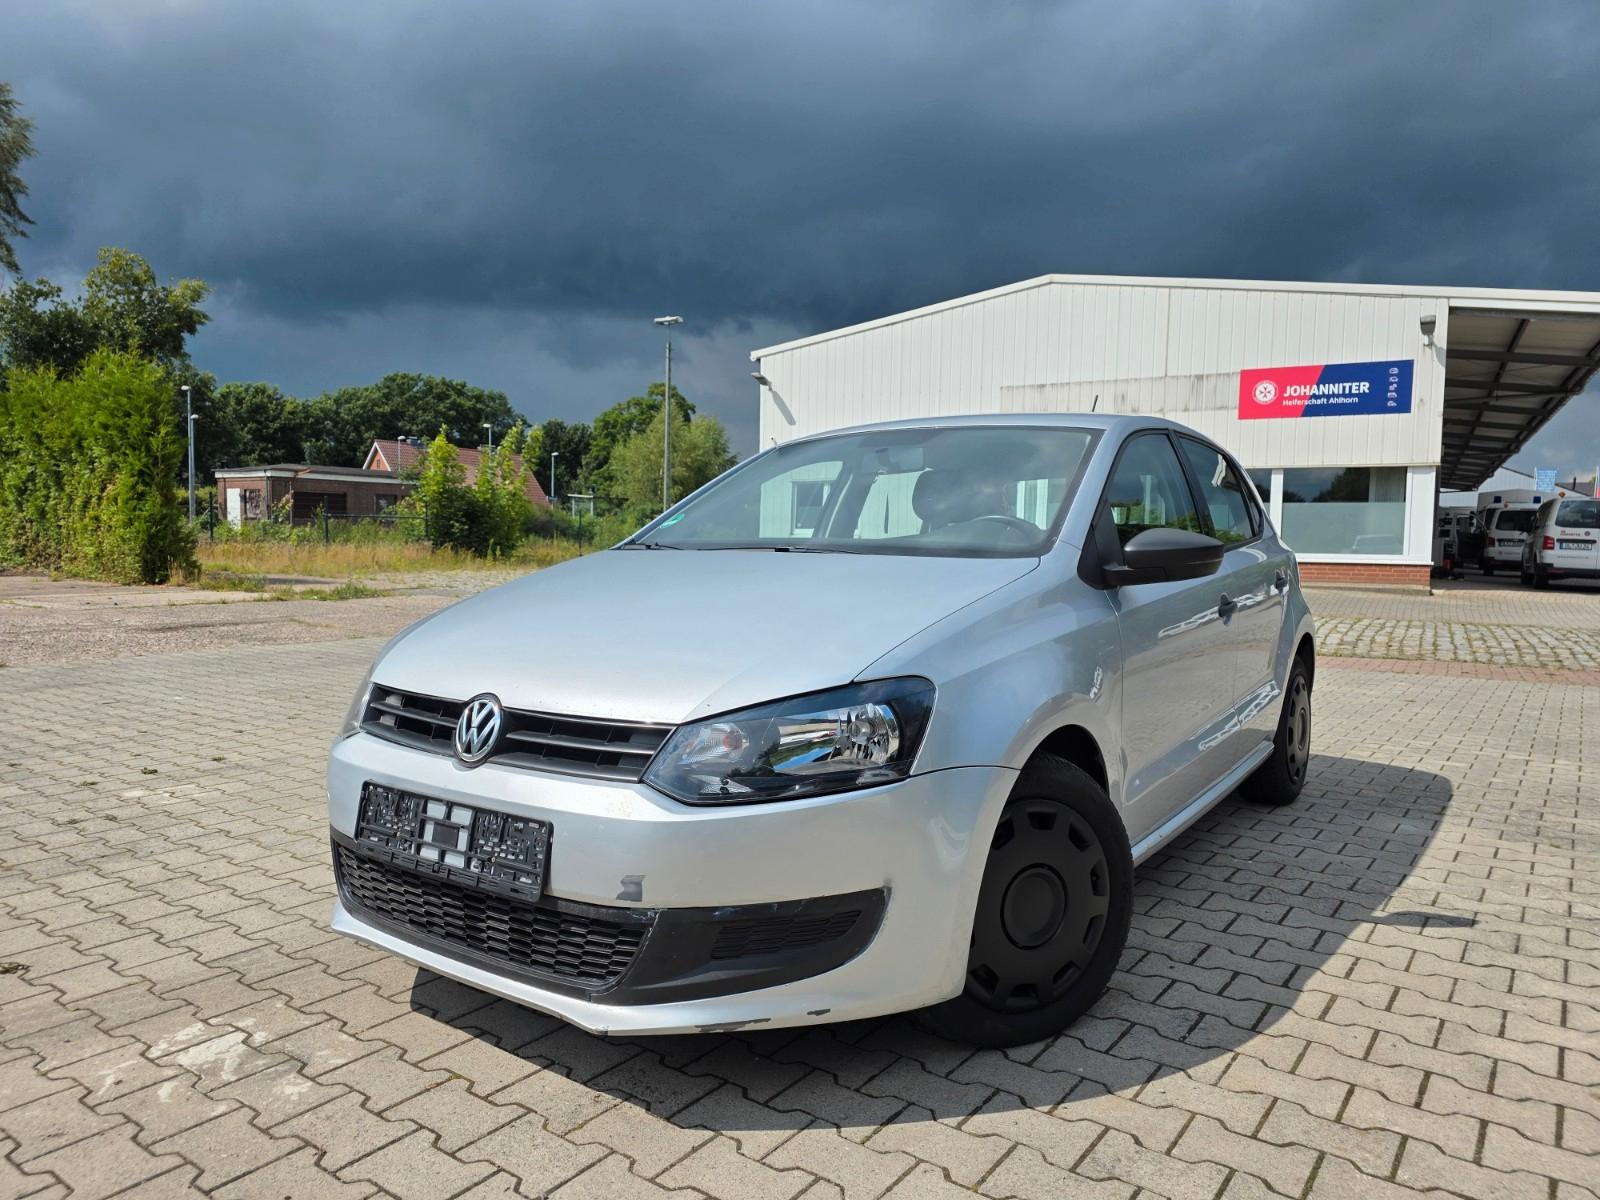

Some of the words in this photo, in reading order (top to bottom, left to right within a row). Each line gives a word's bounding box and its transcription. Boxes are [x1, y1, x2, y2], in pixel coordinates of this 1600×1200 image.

[1283, 382, 1370, 397] JOHANNITER
[1282, 397, 1327, 406] Helferschaft
[457, 700, 500, 760] VW
